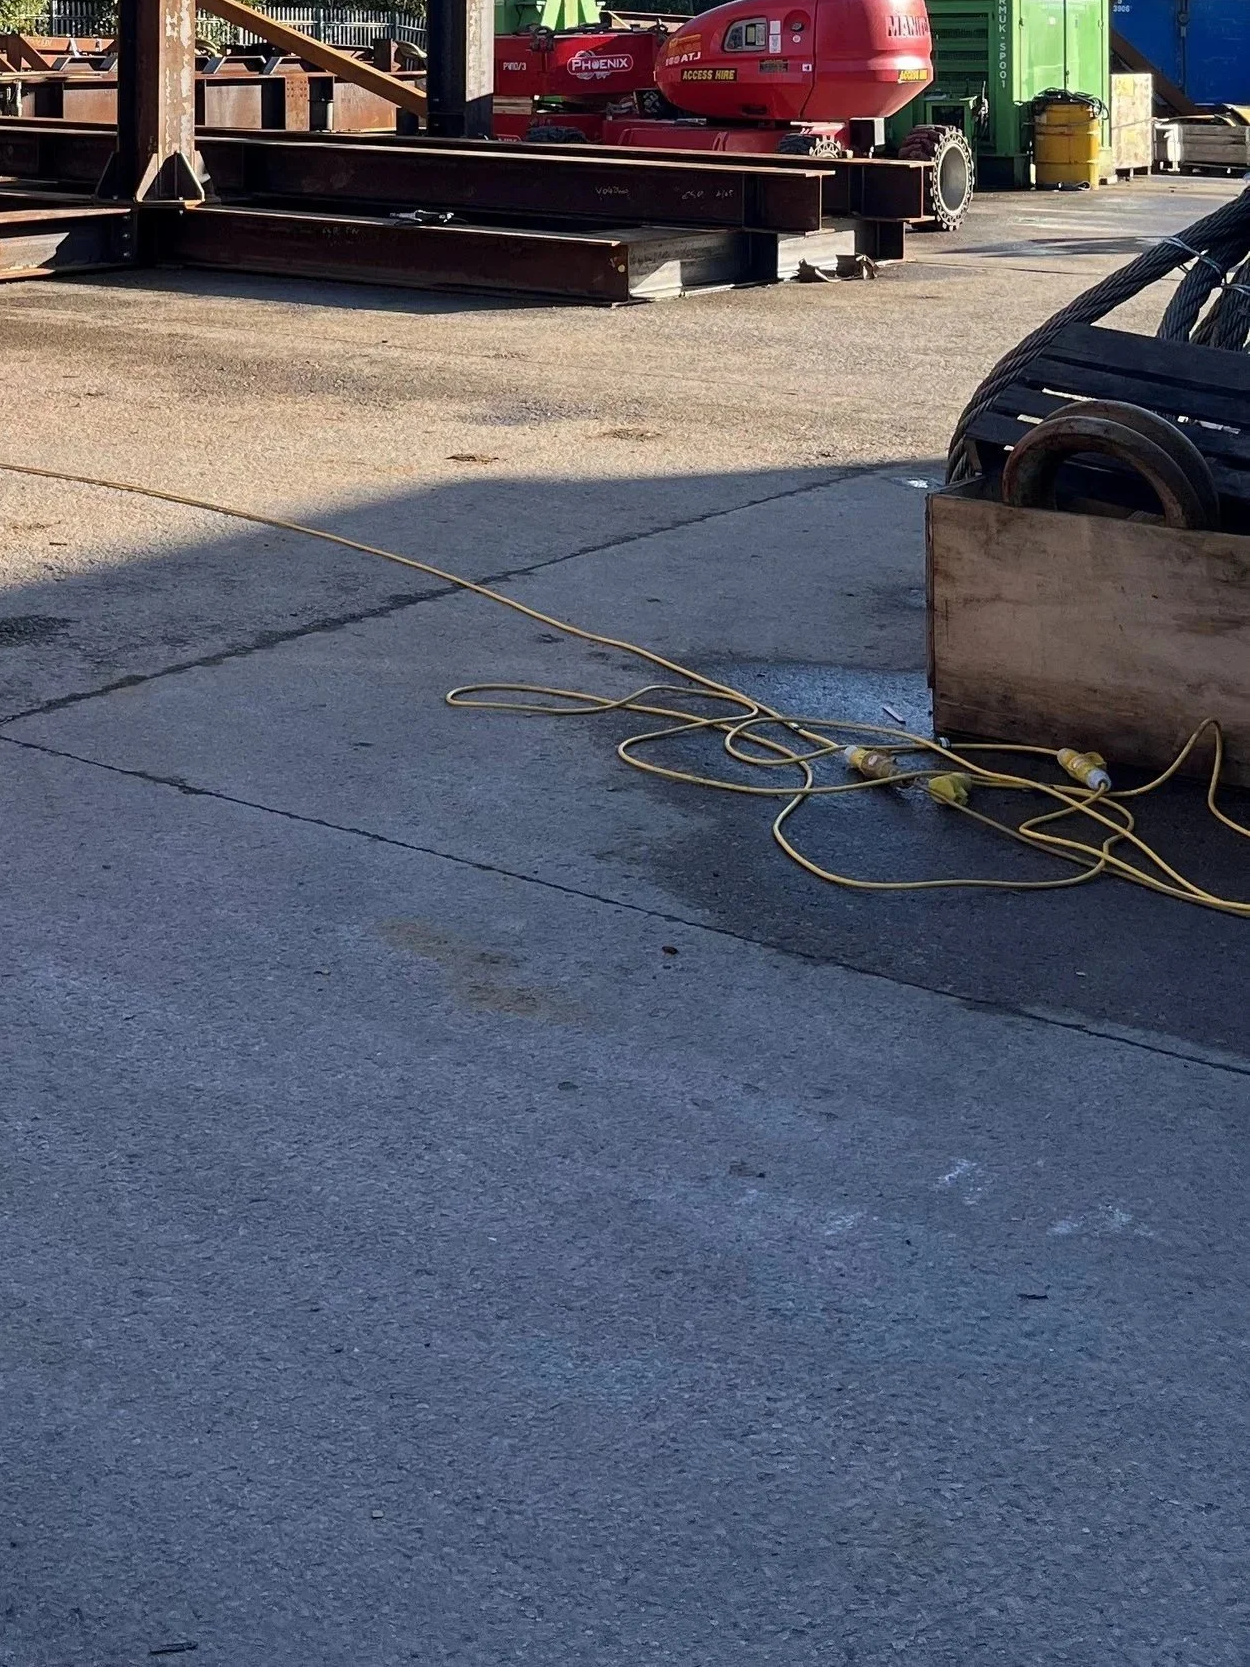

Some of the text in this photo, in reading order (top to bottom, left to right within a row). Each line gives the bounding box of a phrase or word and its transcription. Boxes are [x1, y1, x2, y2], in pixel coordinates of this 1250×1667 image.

[680, 51, 701, 63] ATJ
[571, 57, 629, 72] PHOENIX
[682, 69, 735, 81] ACCESS HIRE
